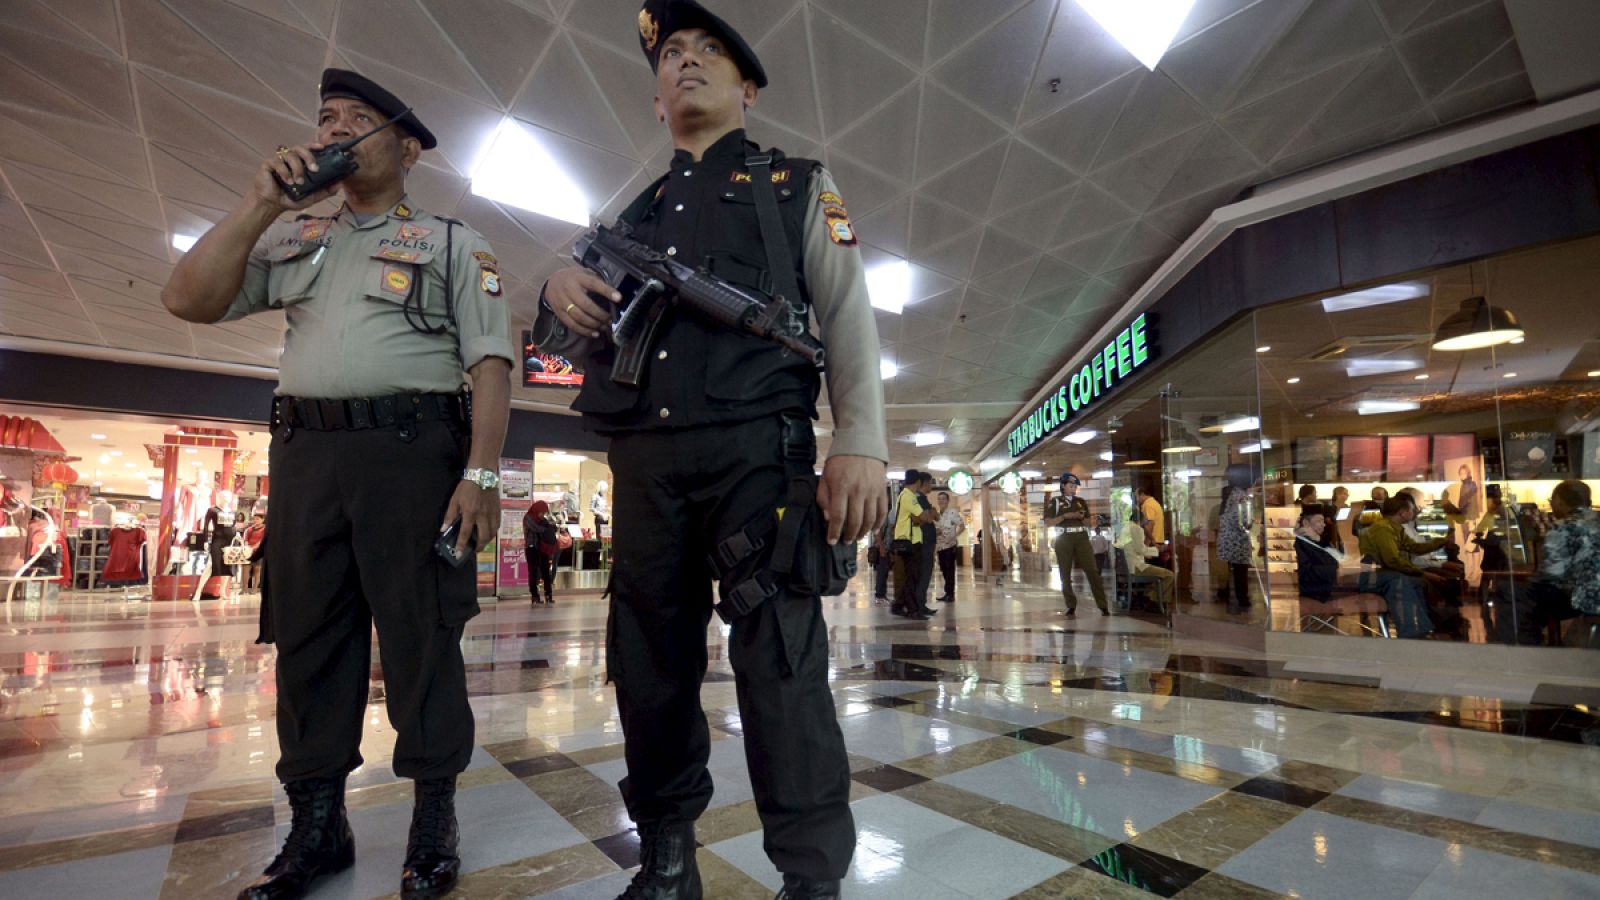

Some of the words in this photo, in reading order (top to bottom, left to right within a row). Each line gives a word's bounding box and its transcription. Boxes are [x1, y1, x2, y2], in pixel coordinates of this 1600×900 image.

[735, 171, 786, 183] POSI
[379, 239, 434, 251] POLISI
[1008, 385, 1068, 458] STARBUCKS
[1069, 313, 1148, 411] COFFEE
